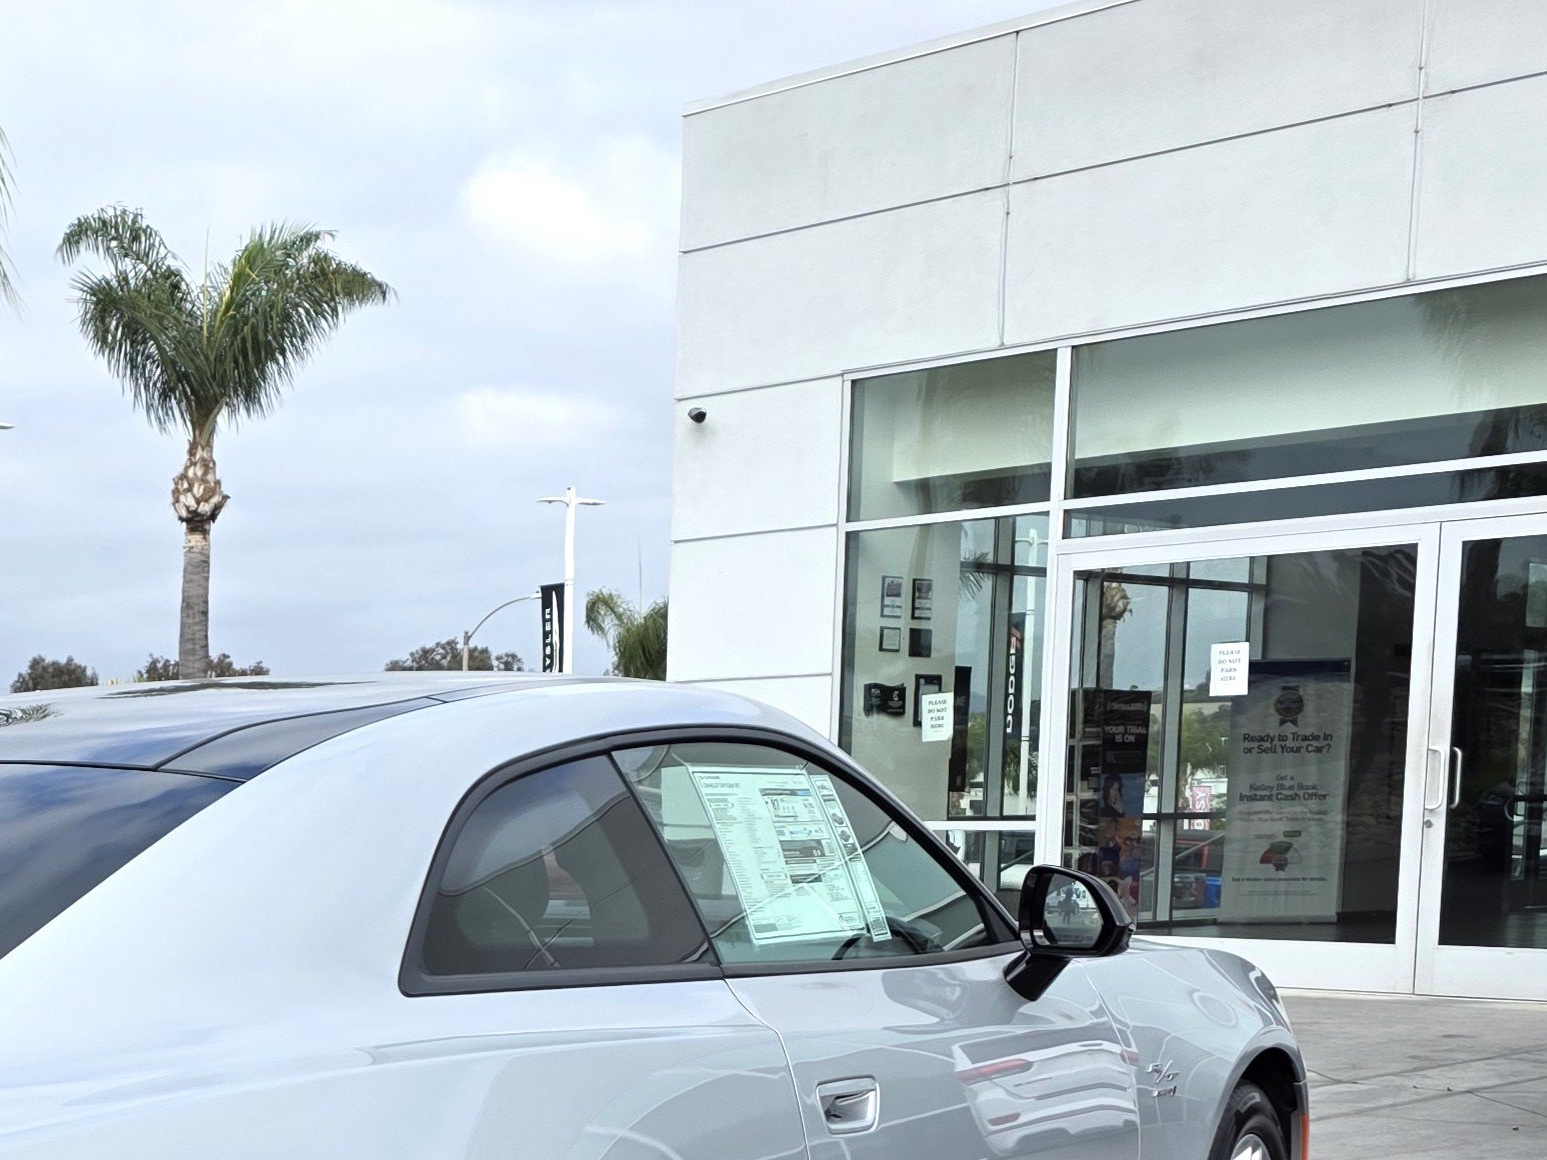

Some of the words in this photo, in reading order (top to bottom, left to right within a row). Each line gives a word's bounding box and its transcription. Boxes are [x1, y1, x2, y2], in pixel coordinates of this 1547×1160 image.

[1006, 635, 1017, 734] DODGE
[1103, 725, 1125, 734] YOUR
[1126, 725, 1147, 734] TRIAL
[1115, 734, 1123, 743] IS
[1124, 734, 1136, 743] ON
[1243, 732, 1274, 744] Ready
[1277, 732, 1288, 743] to
[1290, 732, 1321, 742] Trade
[1242, 745, 1255, 755] or
[1256, 744, 1277, 754] Sell
[1279, 743, 1304, 754] Your
[1305, 743, 1332, 753] Car?
[1249, 783, 1274, 792] Kelley
[1276, 782, 1296, 792] Blue
[1297, 782, 1318, 791] Book
[1238, 792, 1273, 802] Instant
[1275, 792, 1301, 801] Cash
[1302, 791, 1330, 801] Offer
[1146, 1060, 1180, 1084] R/T
